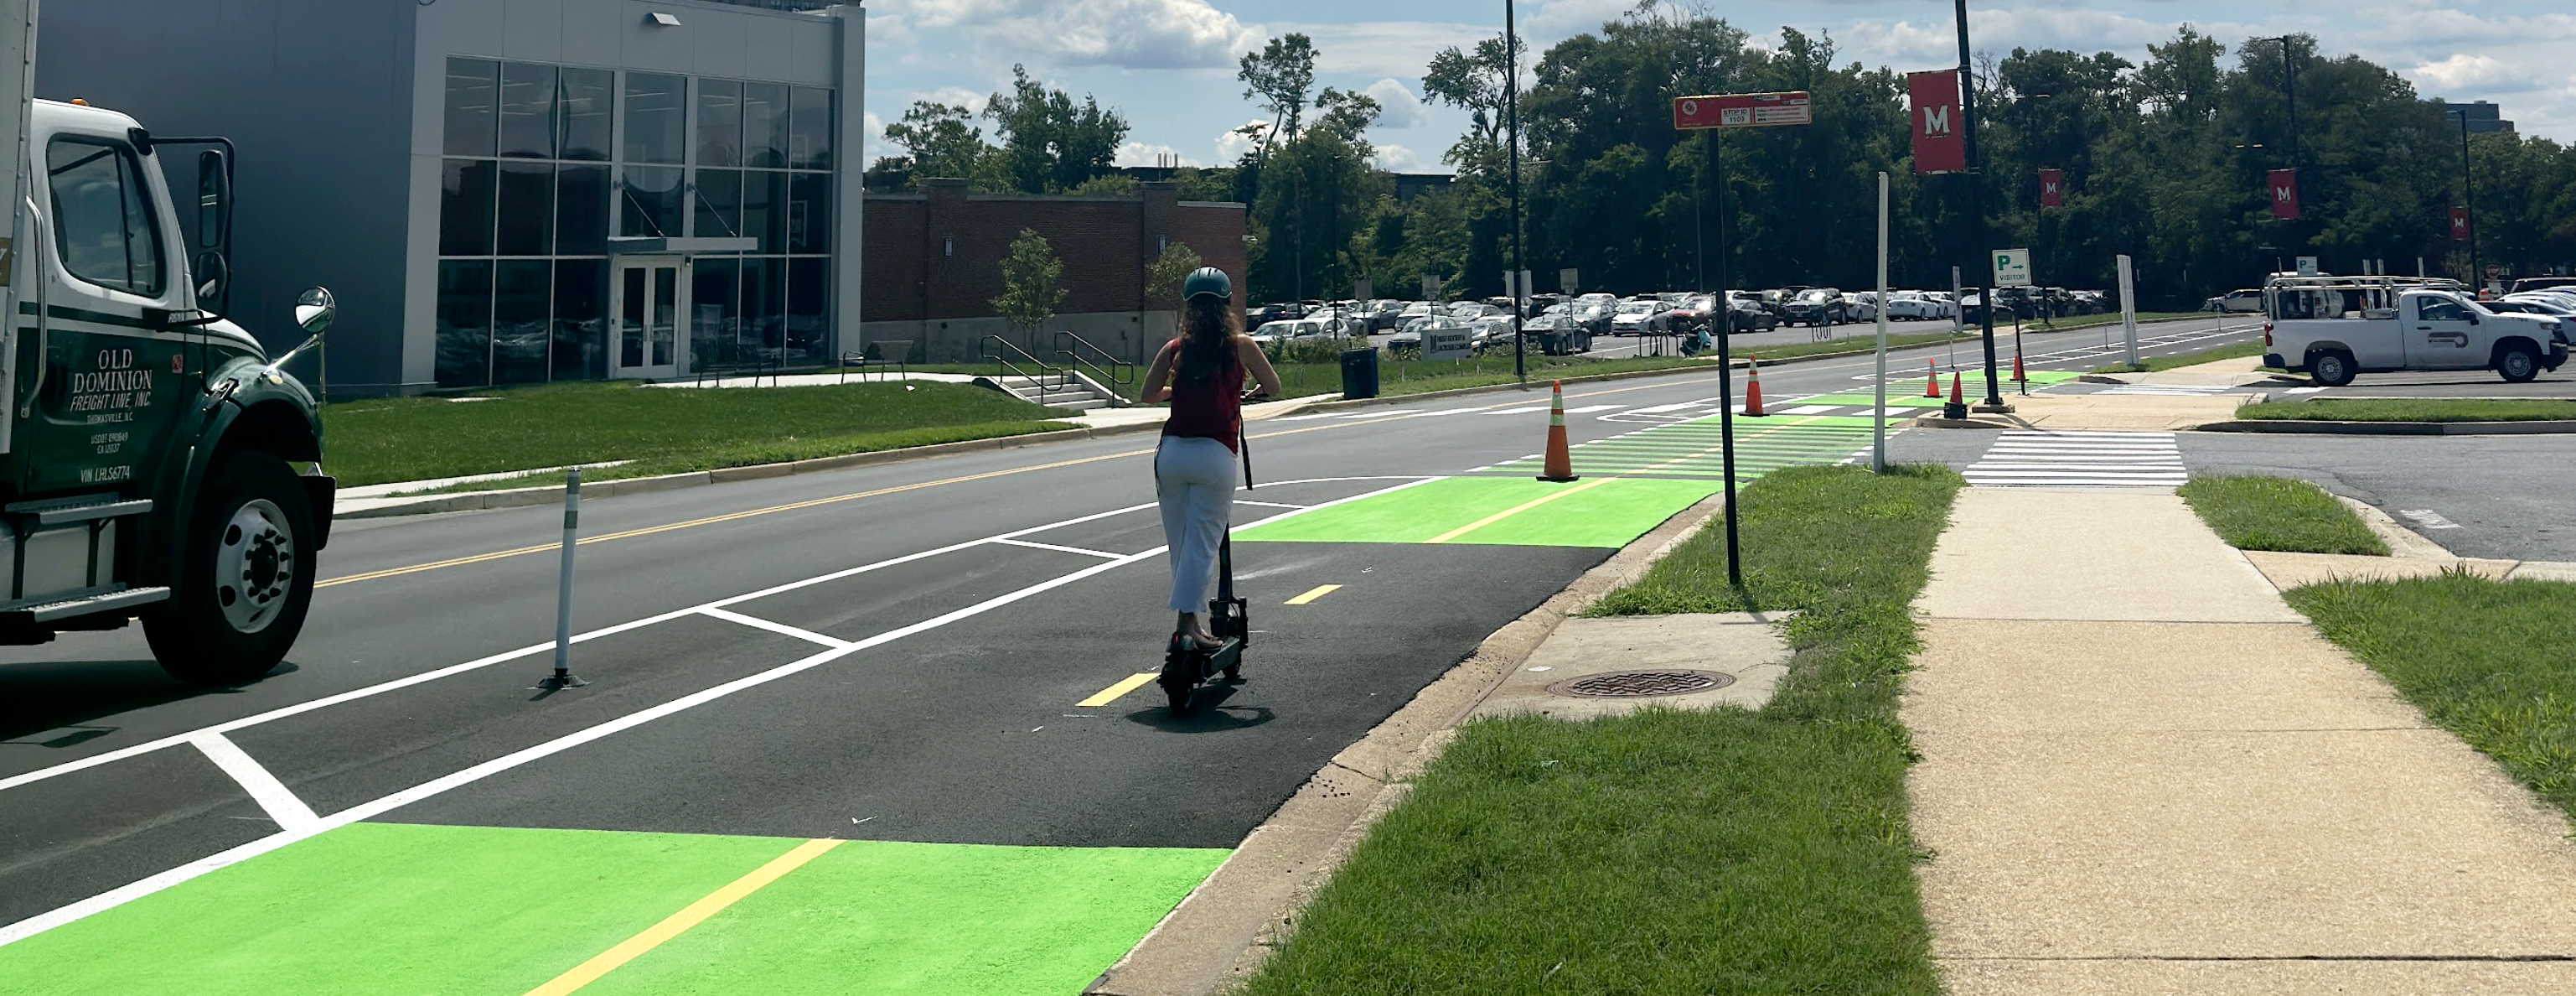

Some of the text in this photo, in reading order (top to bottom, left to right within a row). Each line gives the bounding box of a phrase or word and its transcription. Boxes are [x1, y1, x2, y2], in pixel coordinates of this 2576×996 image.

[1922, 105, 1951, 134] M
[2046, 182, 2056, 193] M
[2277, 186, 2291, 201] M
[2454, 217, 2465, 227] M
[1998, 255, 2010, 271] P
[2299, 260, 2307, 269] P
[98, 348, 132, 370] OLD
[72, 370, 153, 393] DOMINION
[70, 393, 110, 412] FREIGHT
[91, 433, 108, 444] USDOT
[80, 469, 93, 484] VIN
